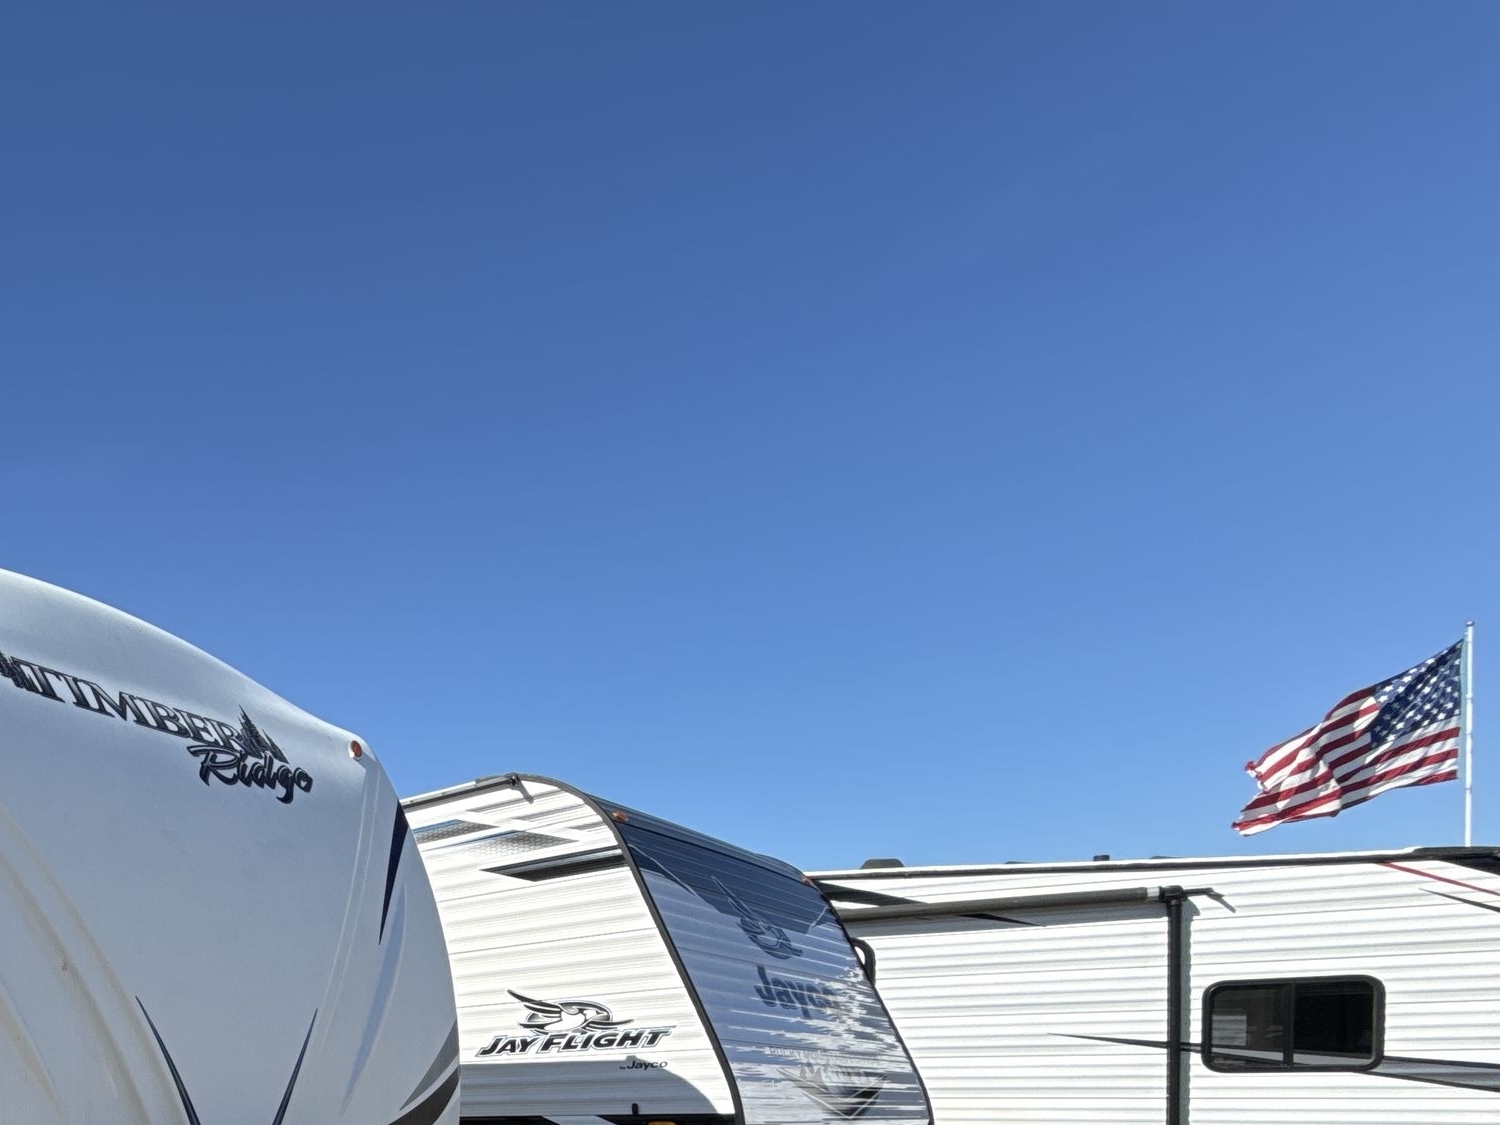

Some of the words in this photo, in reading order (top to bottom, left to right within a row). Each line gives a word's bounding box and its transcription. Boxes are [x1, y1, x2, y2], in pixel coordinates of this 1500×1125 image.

[10, 655, 263, 760] TIMBER
[186, 744, 313, 805] Ridge
[754, 964, 841, 1020] Jayco
[476, 1035, 540, 1057] JAY
[537, 1026, 677, 1054] FLIGHT
[627, 1060, 668, 1071] Jayco
